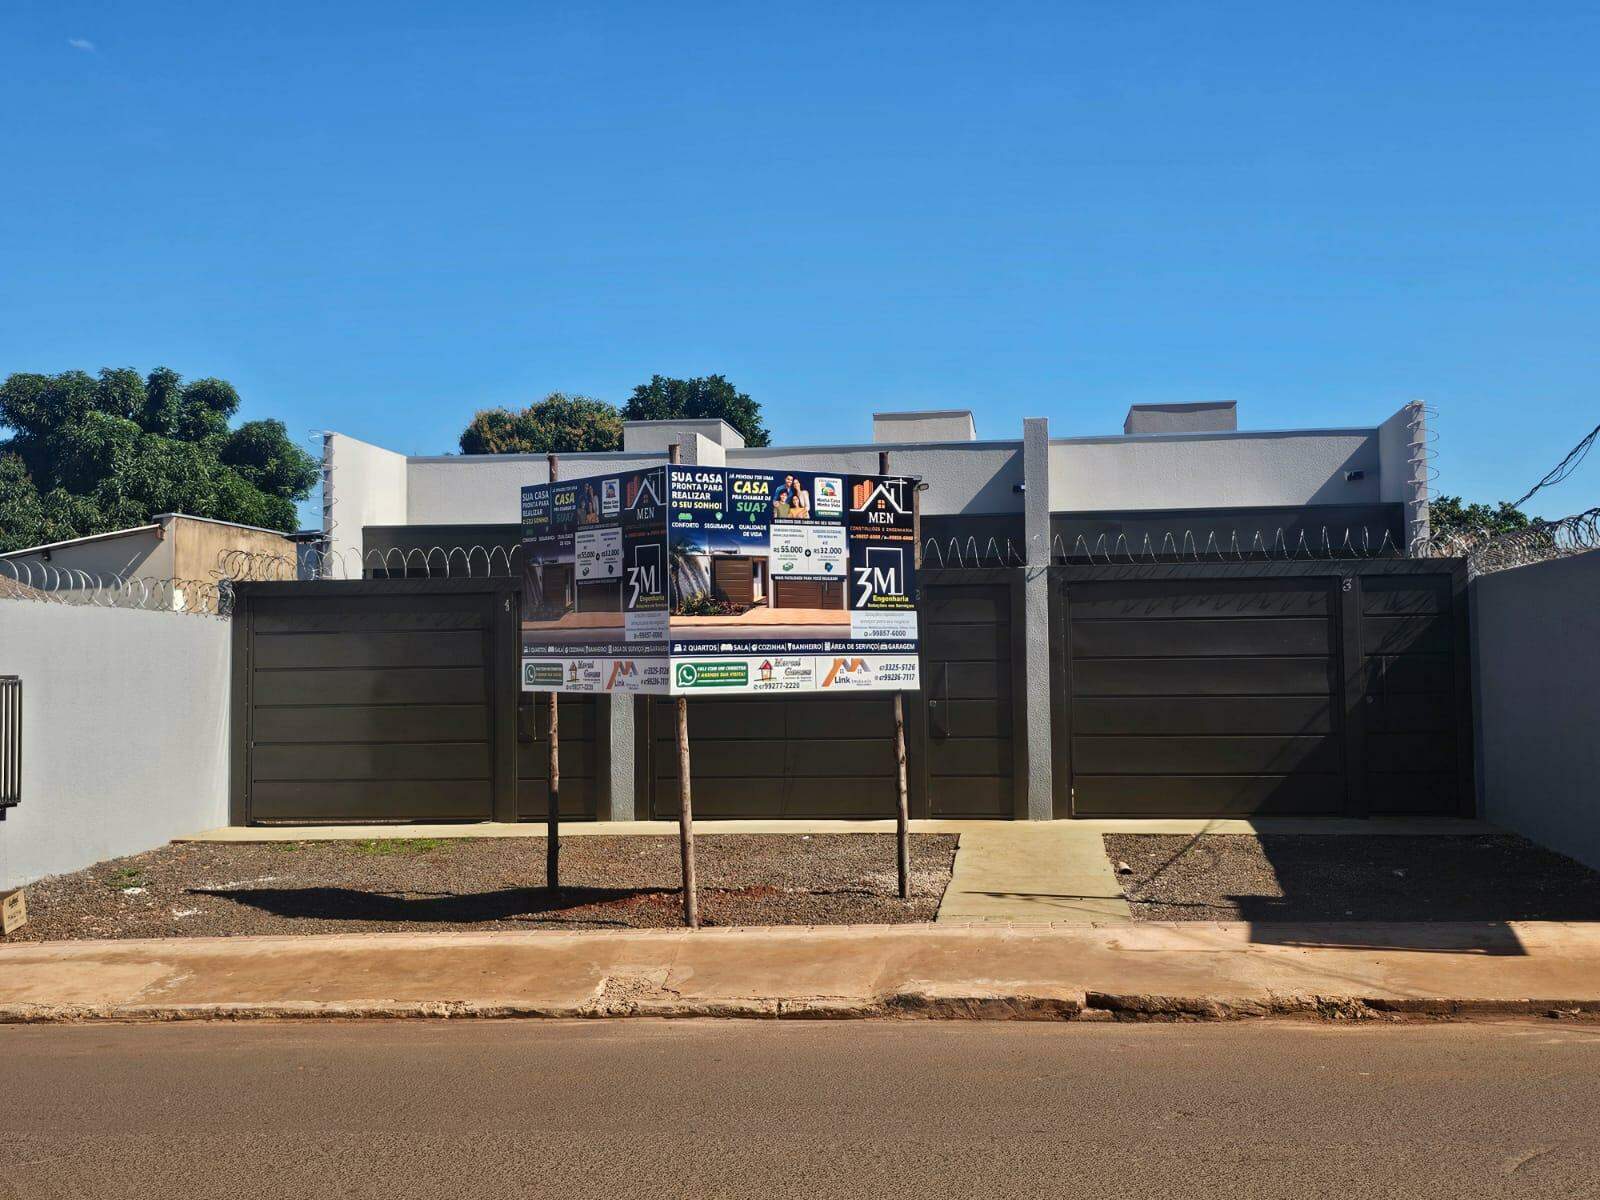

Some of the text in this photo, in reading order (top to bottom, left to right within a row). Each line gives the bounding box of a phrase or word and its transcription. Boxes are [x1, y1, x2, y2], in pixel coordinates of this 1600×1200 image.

[671, 472, 722, 483] SUA CASA
[672, 482, 702, 490] PRONTA
[733, 481, 769, 494] CASA
[522, 490, 550, 502] SUA CASA
[554, 492, 576, 506] CASA
[672, 491, 711, 500] REALIZAR
[636, 507, 655, 520] MEN
[736, 502, 767, 513] SUA?
[868, 512, 894, 524] MEN
[627, 565, 656, 609] 3M
[854, 567, 896, 607] 3M
[834, 676, 850, 684] Link
